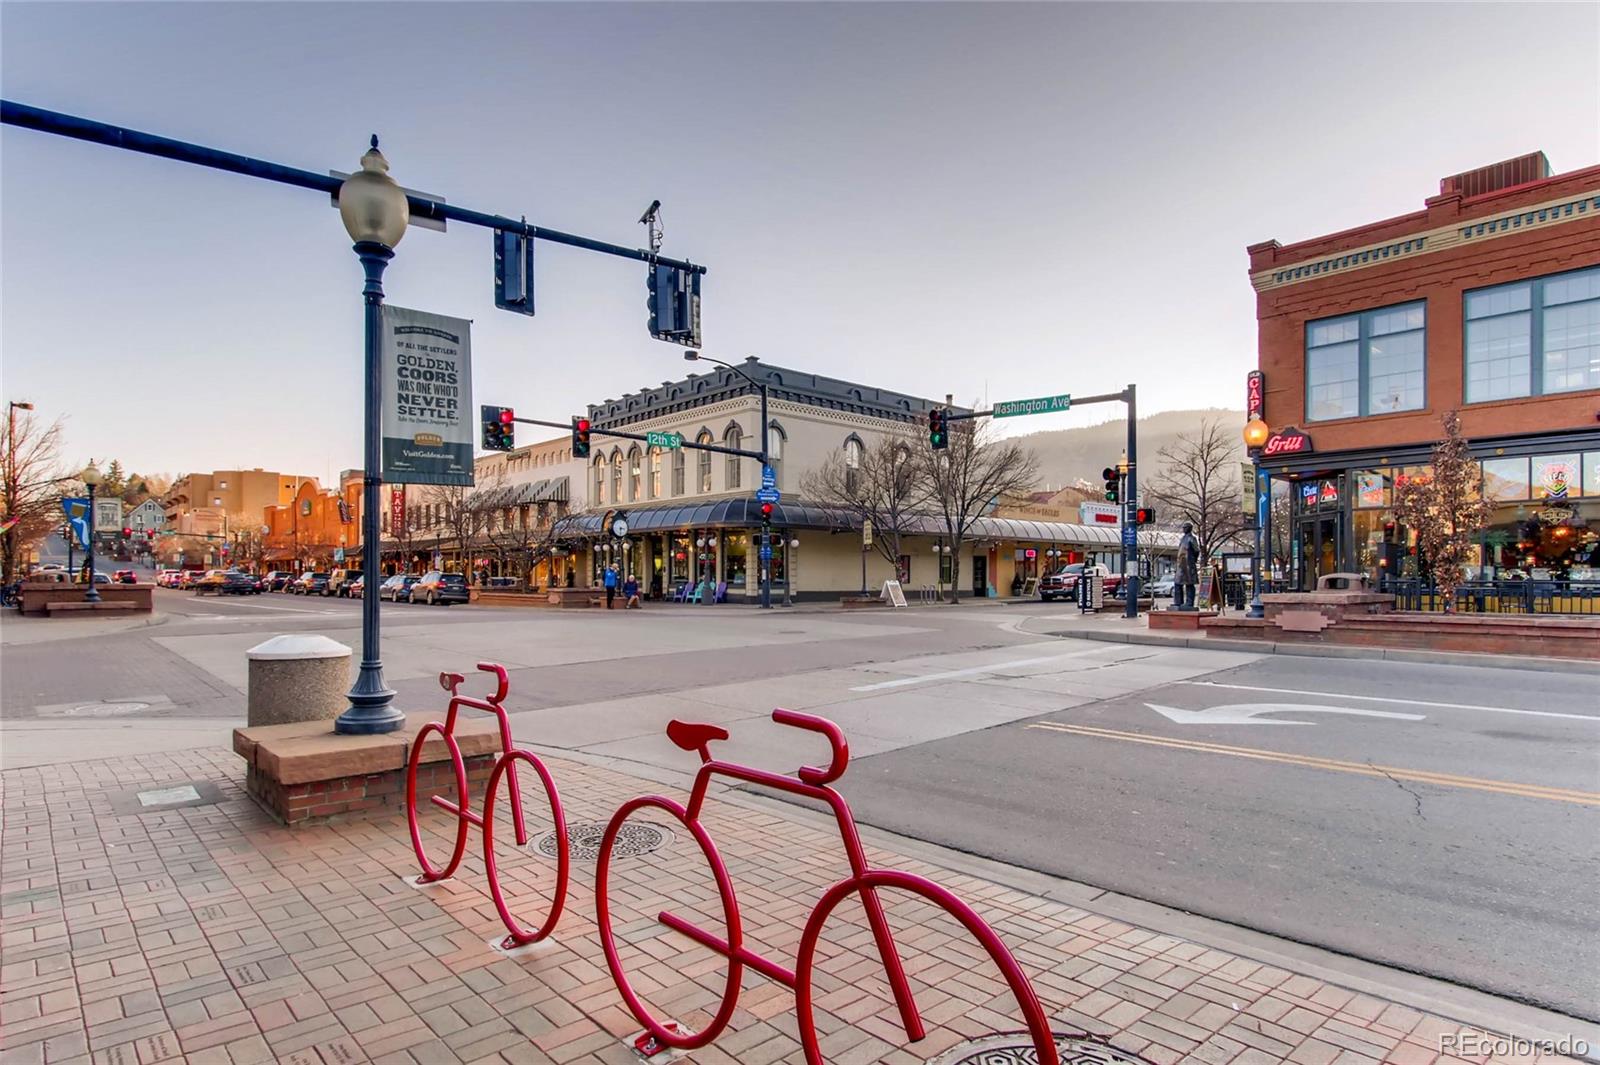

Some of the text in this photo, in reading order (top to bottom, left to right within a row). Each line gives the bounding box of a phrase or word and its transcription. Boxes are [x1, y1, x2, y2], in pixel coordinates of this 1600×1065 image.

[429, 346, 457, 356] SETTLERS
[397, 366, 458, 385] COORS
[397, 379, 458, 398] WAS ONE WHO'D
[397, 392, 458, 410] NEVER
[994, 396, 1070, 415] Washington Ave
[398, 405, 459, 420] SETTLE.
[648, 433, 680, 447] 12th St
[1264, 435, 1303, 454] Grill
[402, 450, 454, 459] VisitGolden.com
